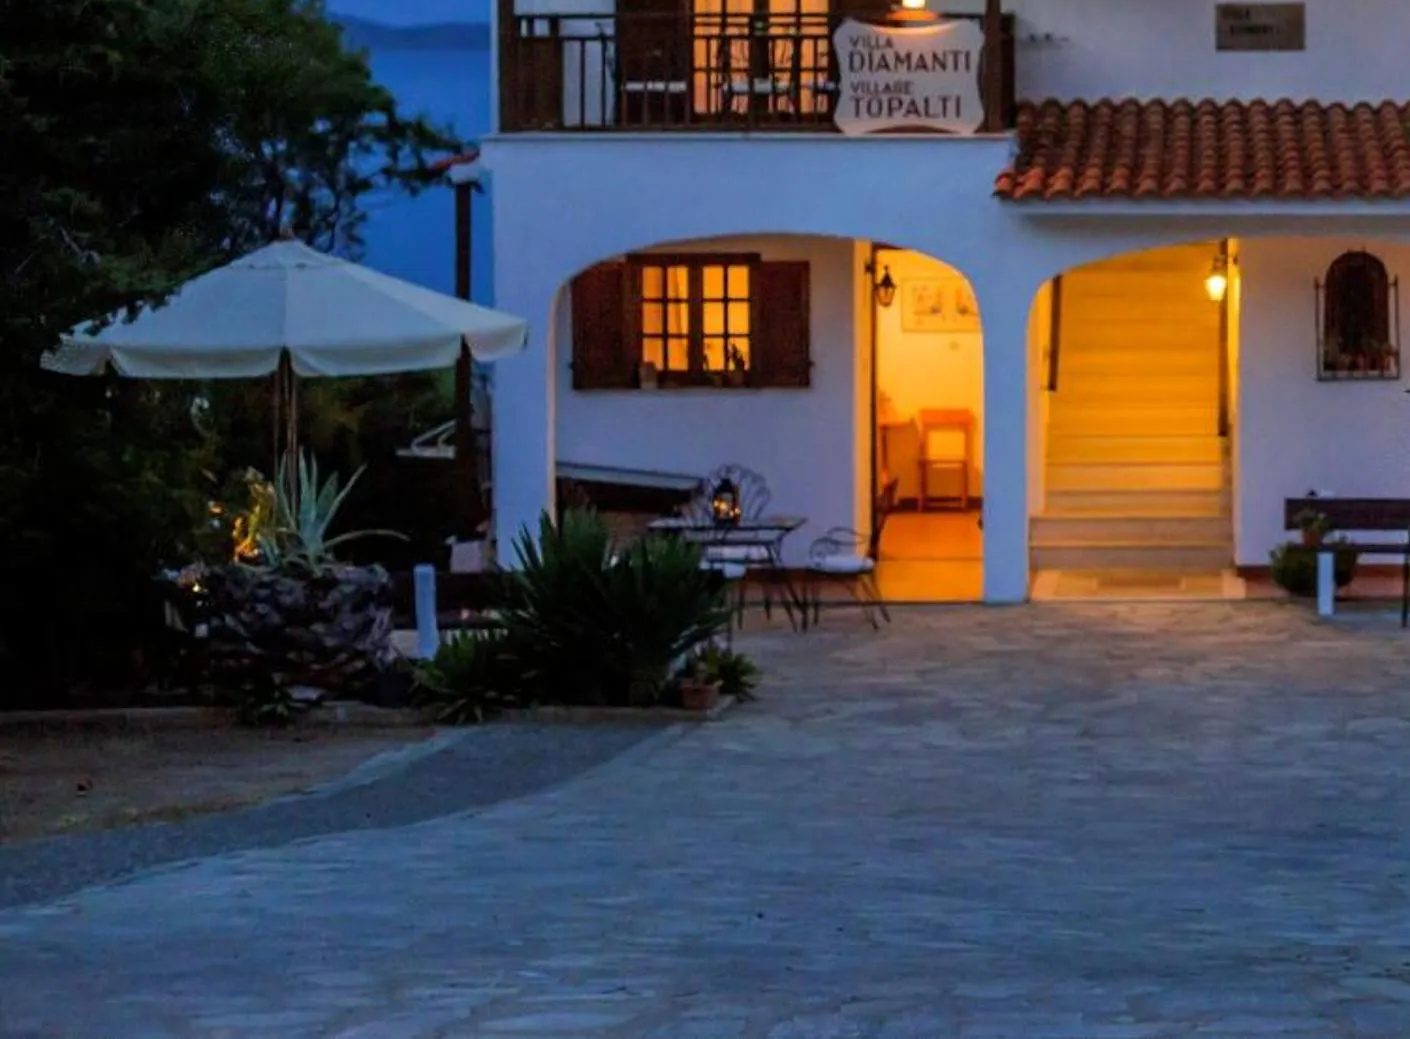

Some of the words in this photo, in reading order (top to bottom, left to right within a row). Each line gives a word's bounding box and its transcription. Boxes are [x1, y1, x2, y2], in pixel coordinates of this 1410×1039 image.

[849, 35, 894, 48] VILLA
[849, 50, 971, 73] DIAMANTI
[851, 96, 962, 118] TOPALTI
